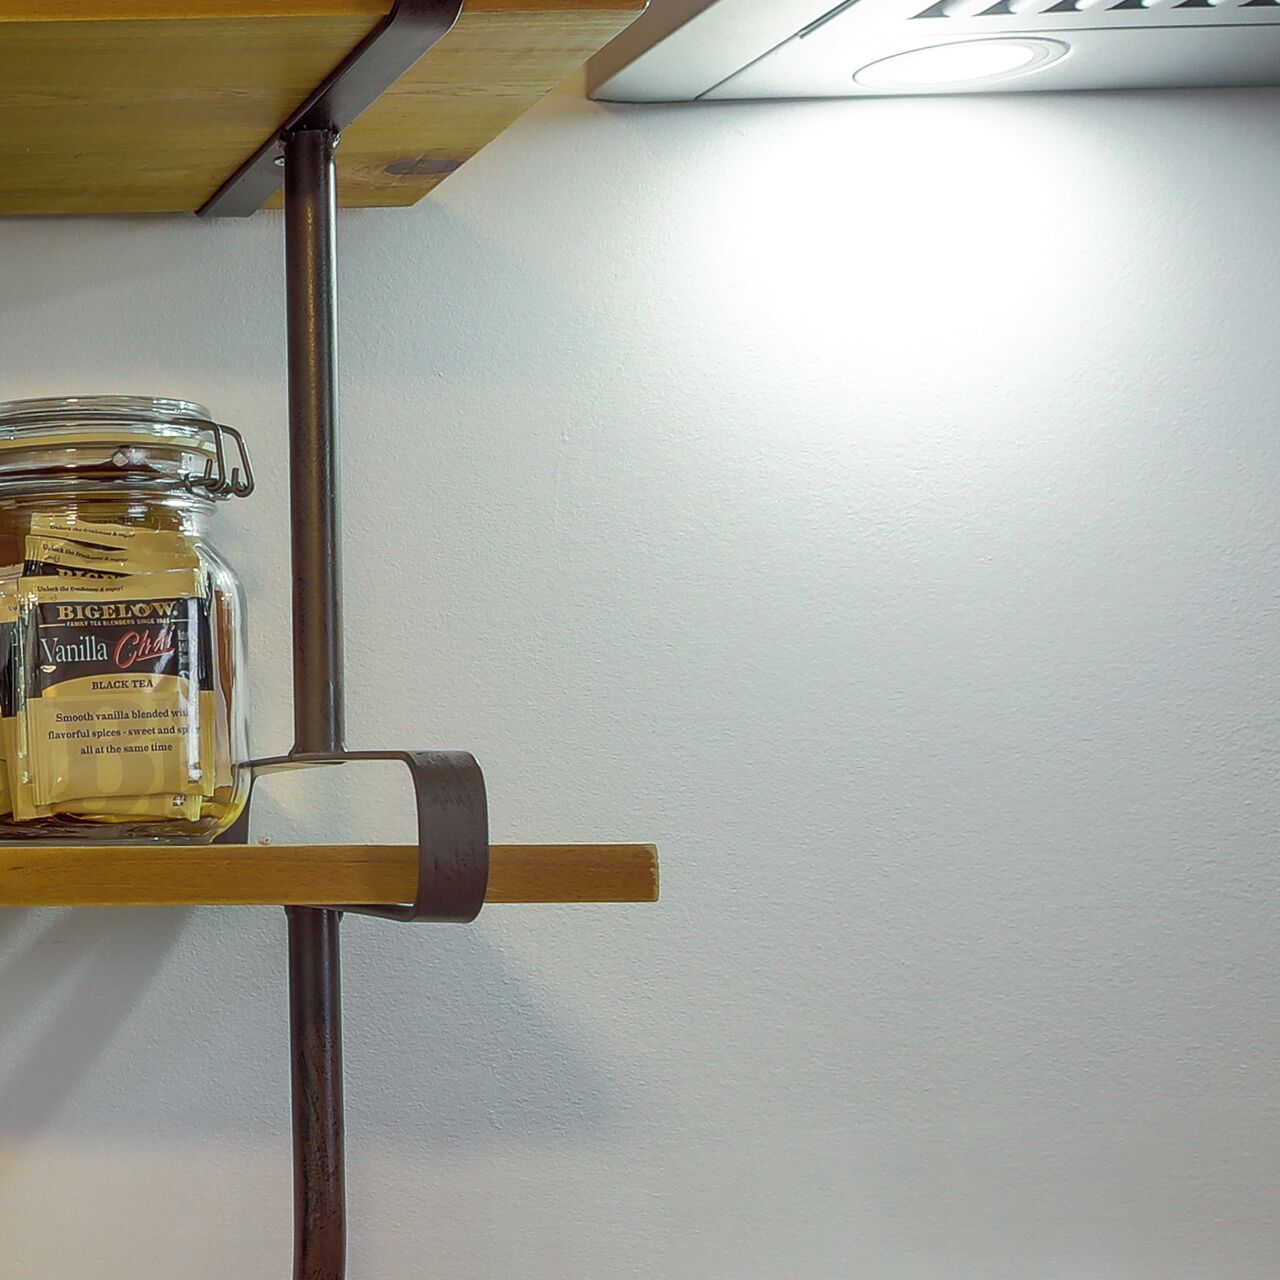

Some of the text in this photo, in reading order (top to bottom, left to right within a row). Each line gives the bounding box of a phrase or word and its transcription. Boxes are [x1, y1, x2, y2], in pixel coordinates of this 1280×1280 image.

[56, 601, 177, 620] BIGELOW
[40, 635, 108, 663] Vanilla
[114, 624, 177, 669] Chai
[91, 678, 154, 691] BLACK TEA
[55, 711, 94, 723] Smooth
[95, 710, 130, 721] vanilla
[131, 709, 169, 719] blended
[48, 727, 90, 740] flavorful
[91, 727, 122, 740] spices
[127, 726, 156, 737] sweet
[157, 725, 176, 734] and
[80, 743, 174, 755] all at the same time
